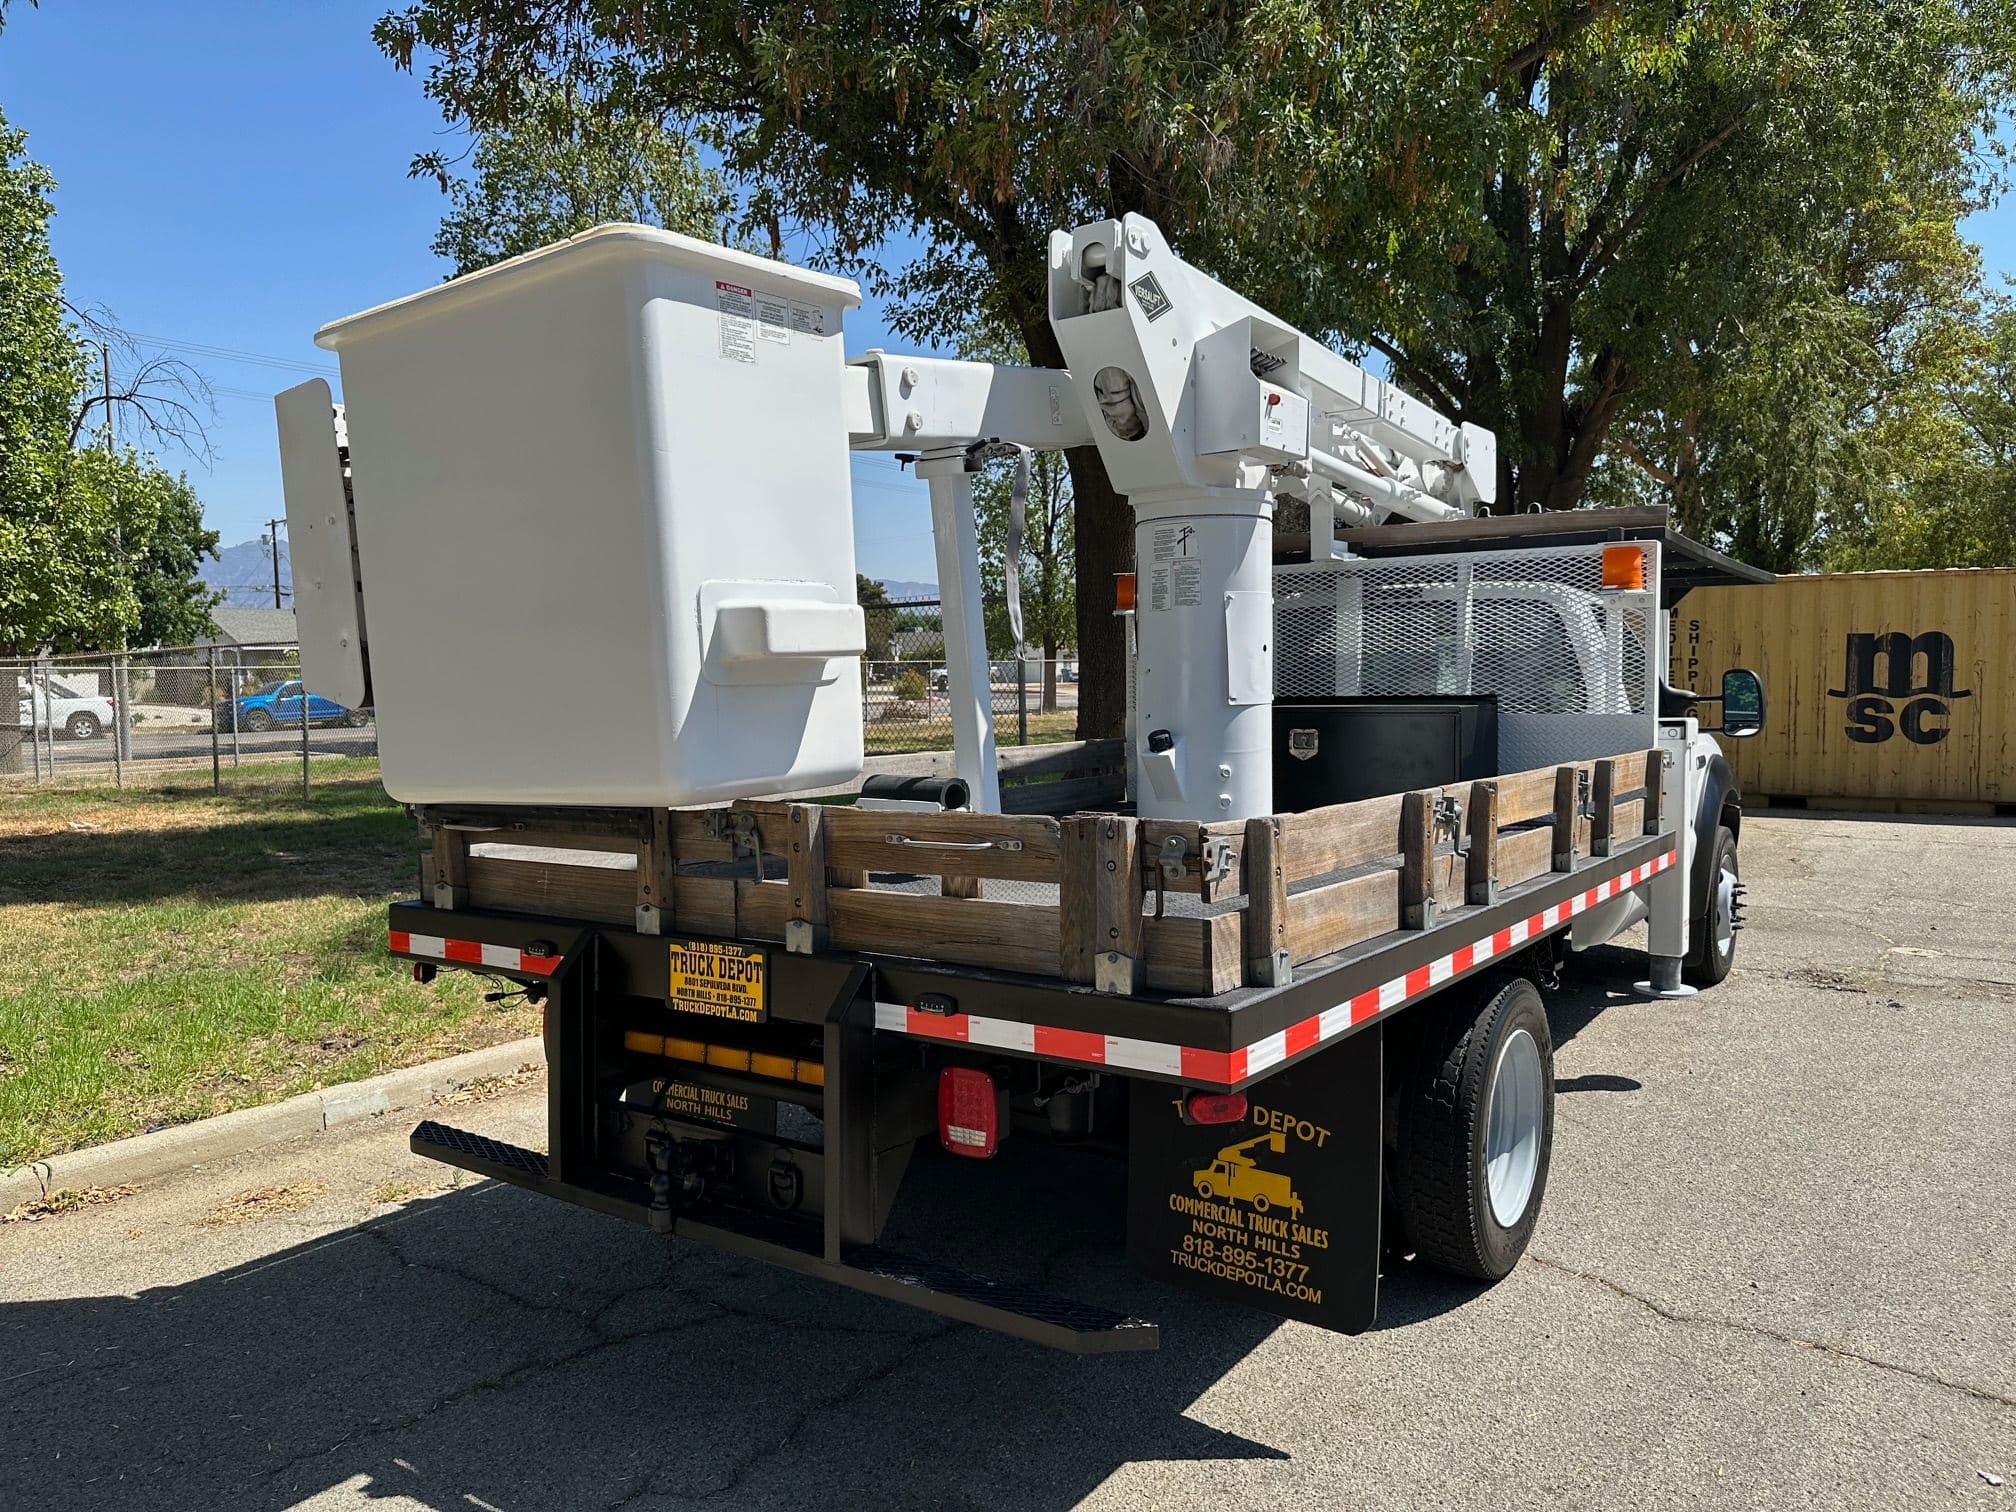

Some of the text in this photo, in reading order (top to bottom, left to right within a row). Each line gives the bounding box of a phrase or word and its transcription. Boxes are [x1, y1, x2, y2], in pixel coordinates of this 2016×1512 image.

[1687, 620, 1700, 718] SHIPPIG
[688, 941, 742, 956] (818) 895-1377
[671, 951, 762, 984] TRUCK DEPOT
[677, 986, 696, 998] NORTH
[696, 989, 712, 1000] HILLS
[700, 978, 731, 991] SEPULVEDA
[672, 998, 758, 1022] TRUCKDEPOTLA.COM
[652, 1080, 749, 1111] COMERCIAL TRUCK SALES
[666, 1098, 732, 1120] NORTH HILLS
[1253, 1105, 1331, 1148] DEPOT
[1169, 1193, 1329, 1249] COMMERCIAL TRUCK SALES
[1192, 1219, 1300, 1259] NORTH HILLS
[1182, 1234, 1309, 1283] 818-895-1377
[1170, 1250, 1322, 1305] TRUCKDEPOTLA.COM
